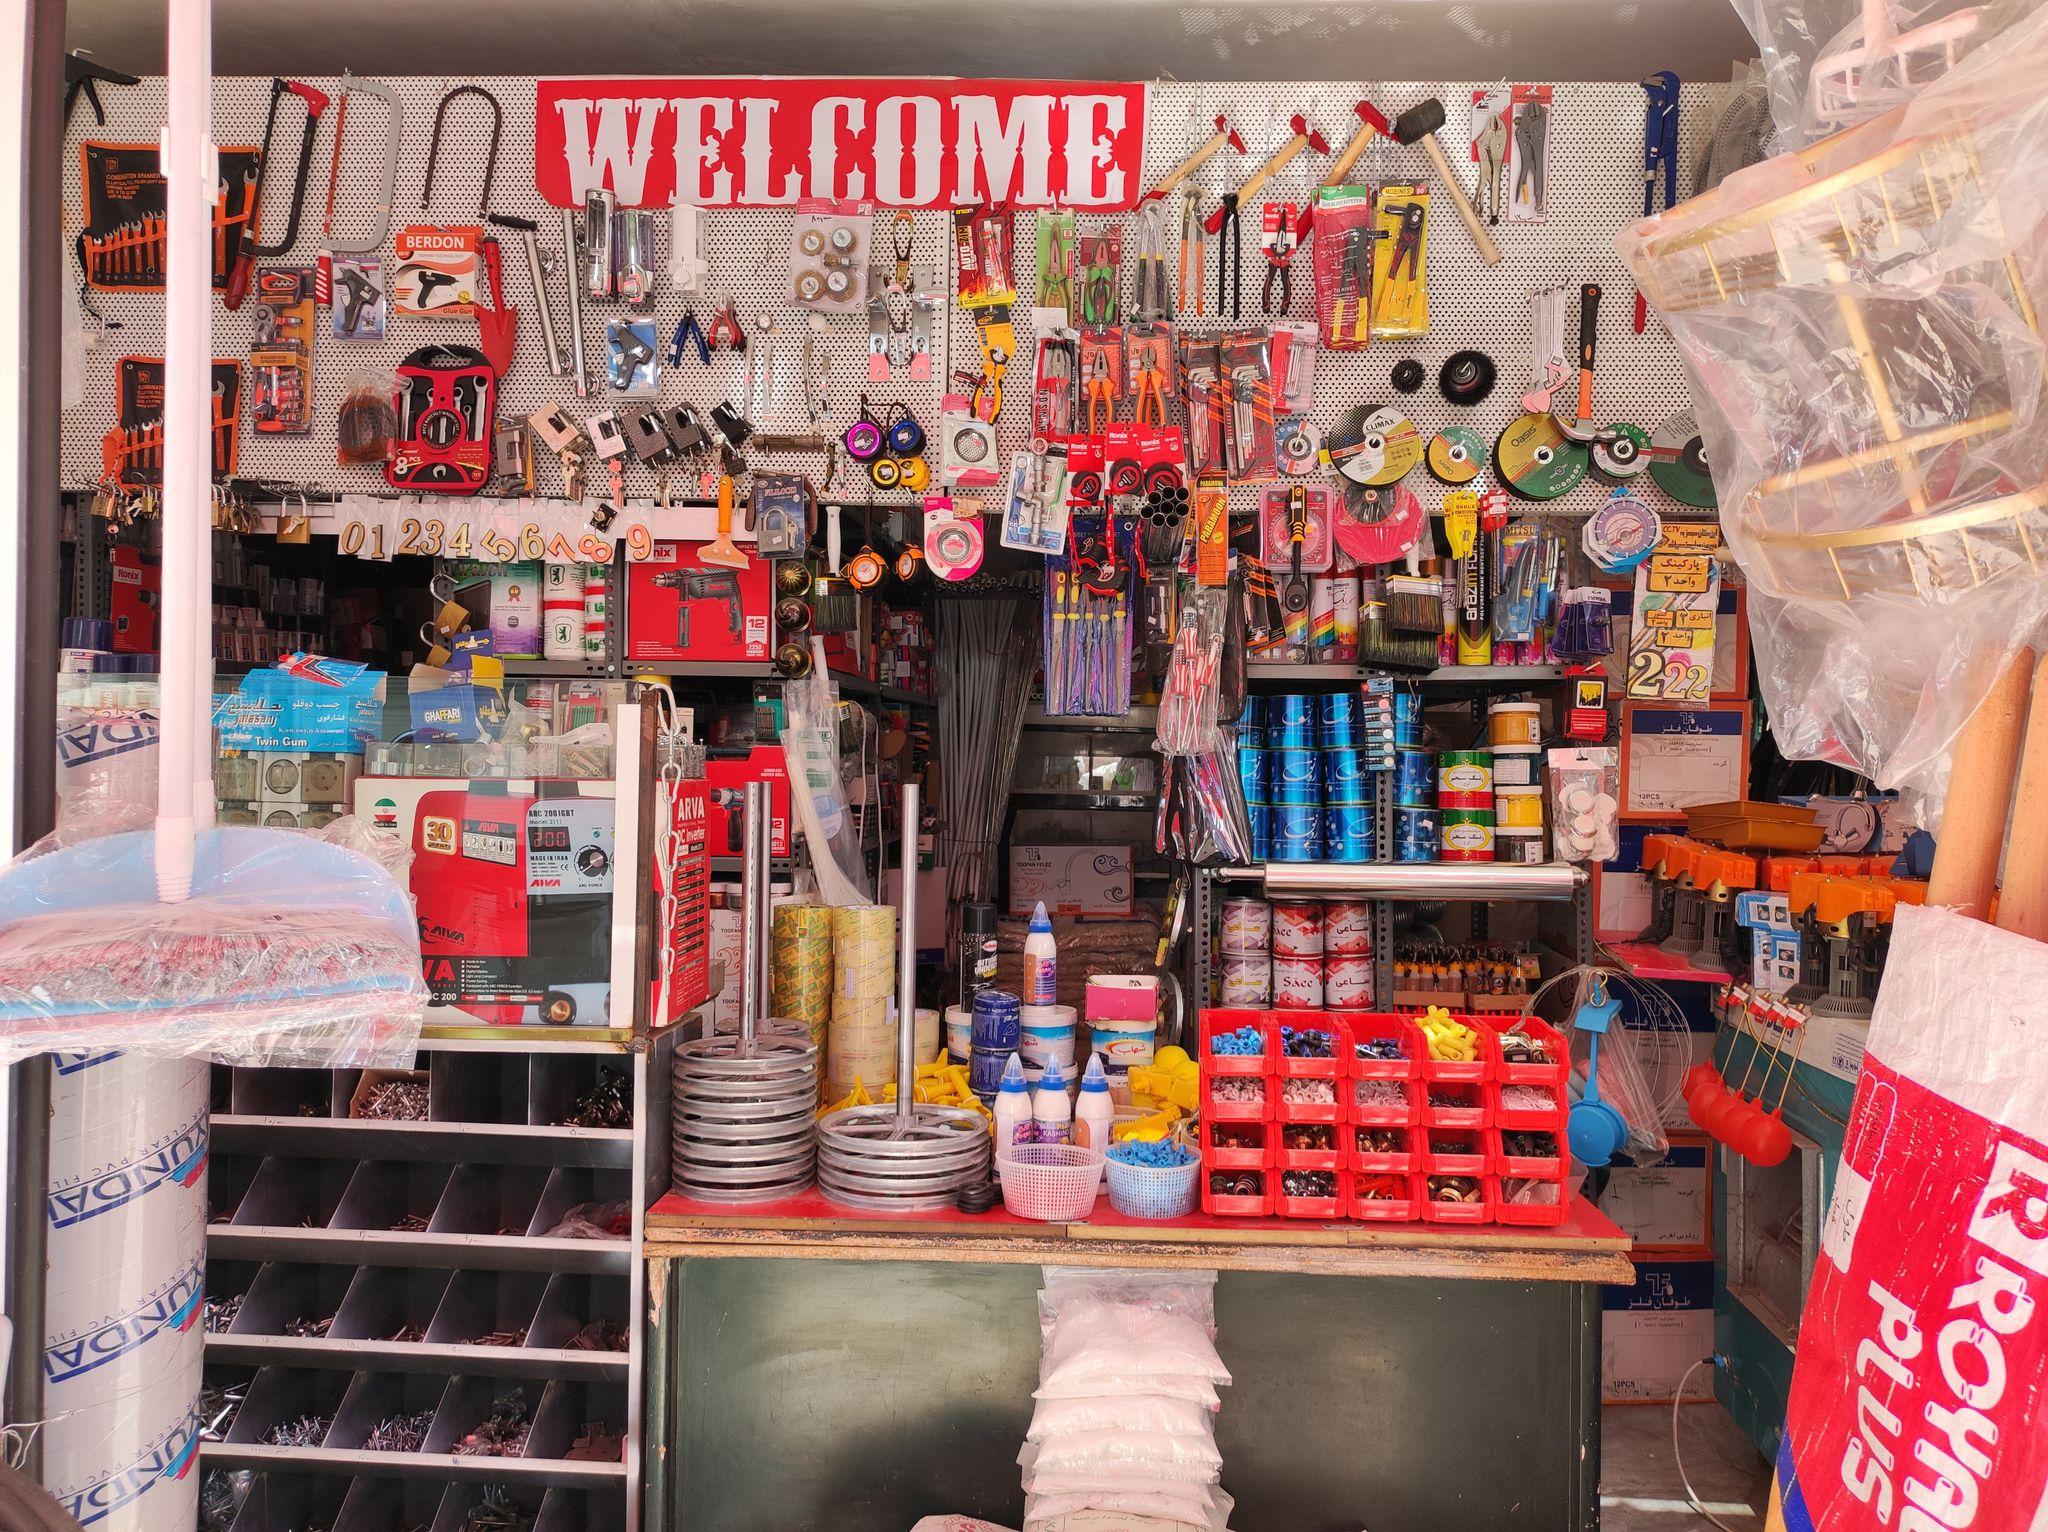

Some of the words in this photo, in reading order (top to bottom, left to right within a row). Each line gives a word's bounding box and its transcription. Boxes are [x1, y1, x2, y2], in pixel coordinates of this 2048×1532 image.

[553, 95, 1127, 206] WELCOME
[406, 235, 464, 249] BERDON
[442, 307, 457, 315] Glue
[1365, 417, 1396, 431] CLIMAX
[1511, 425, 1537, 448] Oasis
[1200, 496, 1227, 544] PARAMOON
[341, 520, 365, 554] 0
[372, 525, 385, 559] 1
[401, 519, 421, 554] 2
[420, 519, 444, 556] 3
[449, 522, 472, 557] 4
[481, 529, 516, 562] 5
[521, 524, 545, 560] 6
[626, 523, 652, 561] 9
[578, 533, 612, 563] 8
[117, 569, 141, 580] Ronix
[1661, 557, 1700, 571] پارکینگ
[1664, 575, 1673, 587] ۲
[1673, 576, 1696, 588] واحد
[747, 618, 765, 629] 12
[424, 707, 461, 723] GHAFFARI
[255, 736, 280, 747] Twin
[282, 736, 308, 748] Gum
[677, 796, 705, 821] ARVA
[427, 821, 453, 843] 30
[533, 831, 567, 848] 200
[686, 828, 706, 842] Inverter
[441, 992, 457, 1001] 200
[91, 1156, 129, 1176] PVC
[1841, 1279, 1923, 1526] PLUS
